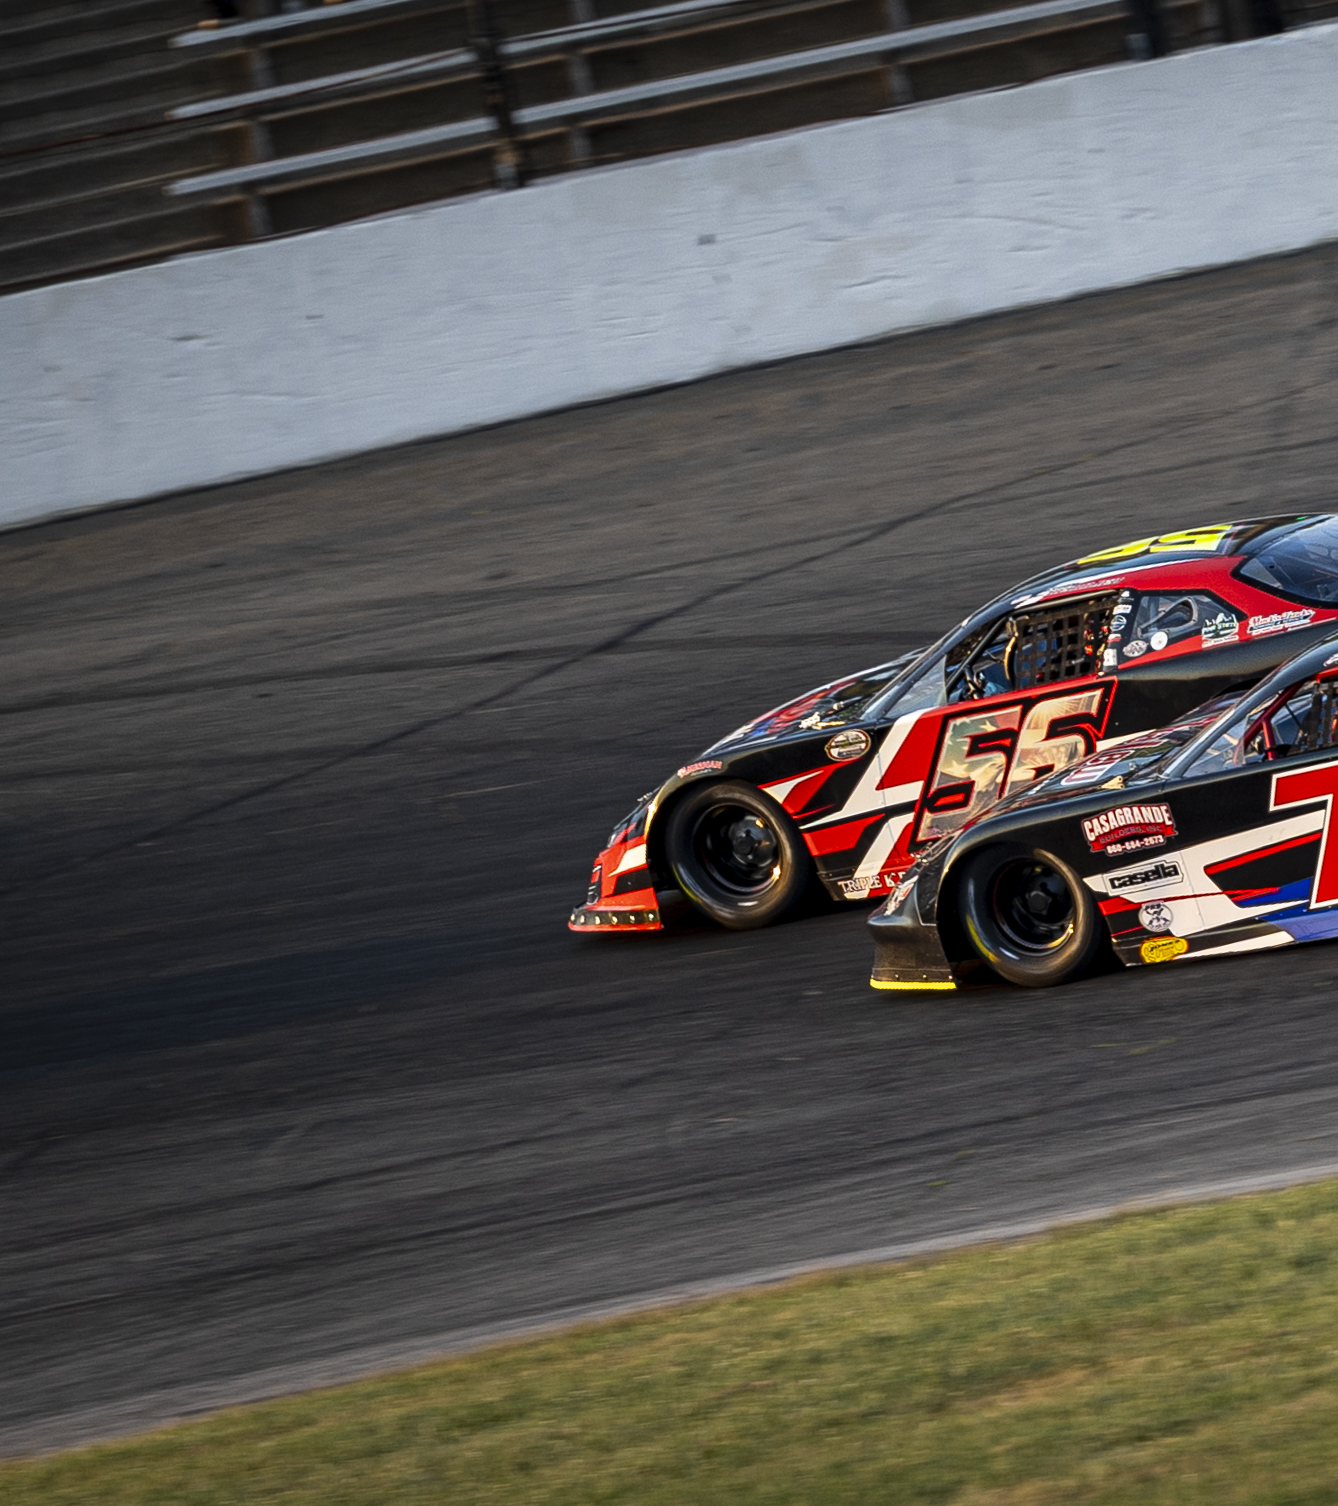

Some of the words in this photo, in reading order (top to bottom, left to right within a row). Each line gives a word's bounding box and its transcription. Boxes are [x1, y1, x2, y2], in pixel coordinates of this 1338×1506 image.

[916, 687, 1106, 843] 56
[1083, 805, 1174, 842] CASAGRANDE
[837, 873, 883, 894] TRIPLE
[1108, 862, 1180, 890] casella
